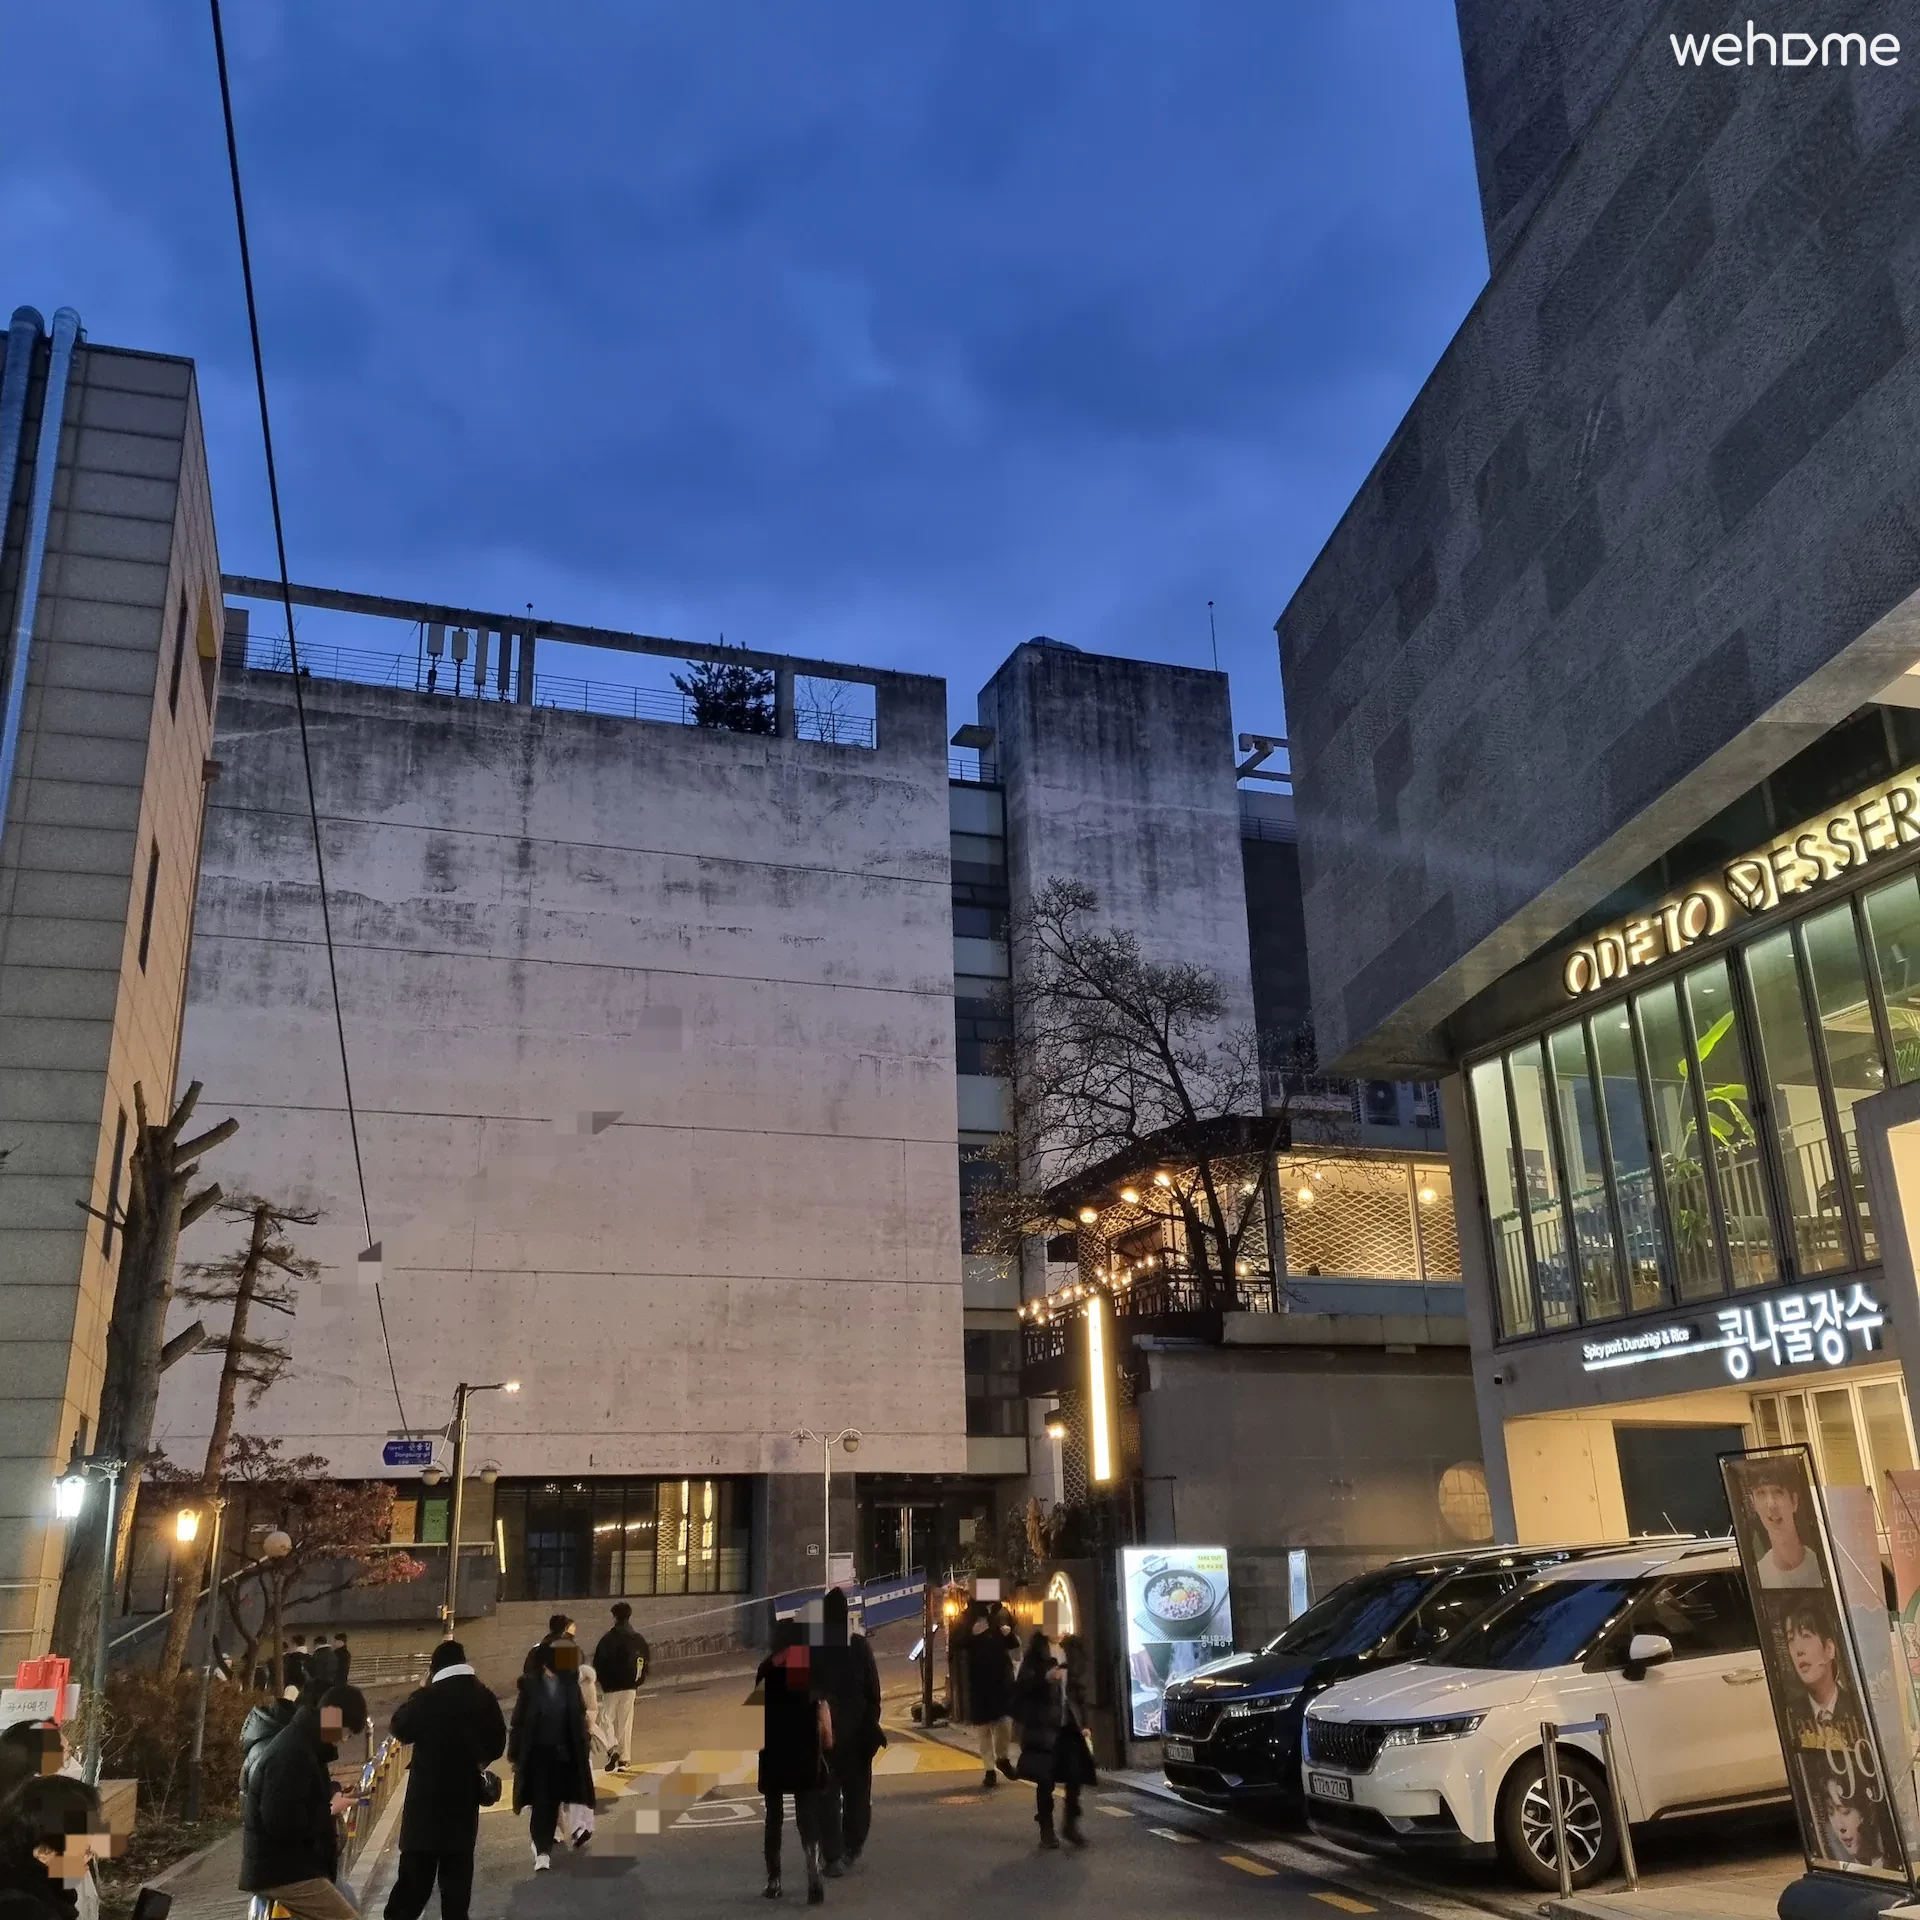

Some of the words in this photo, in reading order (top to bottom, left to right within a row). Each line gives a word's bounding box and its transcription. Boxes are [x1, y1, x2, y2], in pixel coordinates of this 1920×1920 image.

[1563, 920, 1658, 999] ODE
[1652, 890, 1726, 954] TO
[1724, 776, 1920, 916] DESSER
[1583, 1343, 1605, 1360] Spicy
[1605, 1338, 1623, 1358] pork
[1622, 1331, 1661, 1352] Duruchigi
[1661, 1330, 1670, 1345] &
[1669, 1328, 1690, 1343] Rice
[1717, 1283, 1884, 1379] 콩나물장수
[1825, 1736, 1884, 1803] 99
